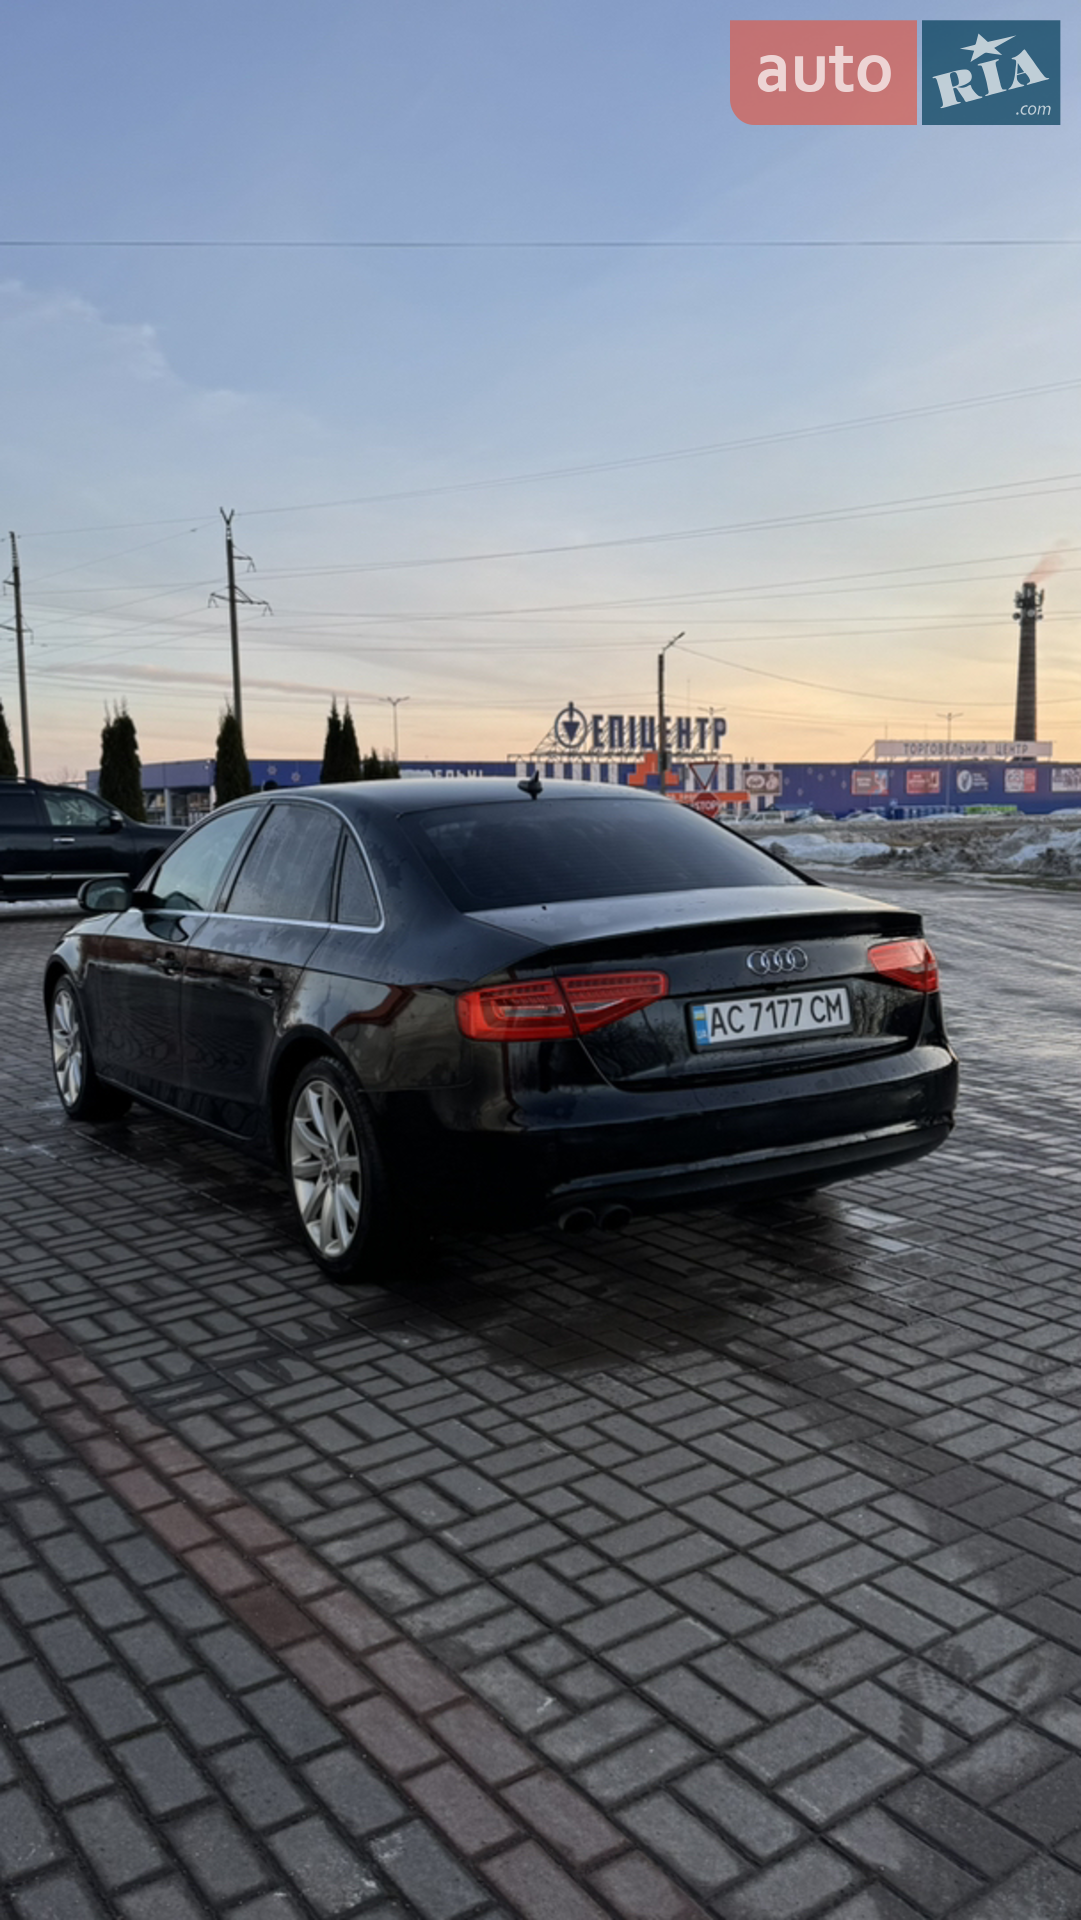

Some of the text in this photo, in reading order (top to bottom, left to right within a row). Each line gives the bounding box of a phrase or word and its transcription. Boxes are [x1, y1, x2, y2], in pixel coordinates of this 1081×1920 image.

[592, 714, 727, 752] ЕПІЦЕНТР
[995, 743, 1029, 756] ЦЕНТР
[711, 993, 844, 1037] AC 7177 CM
